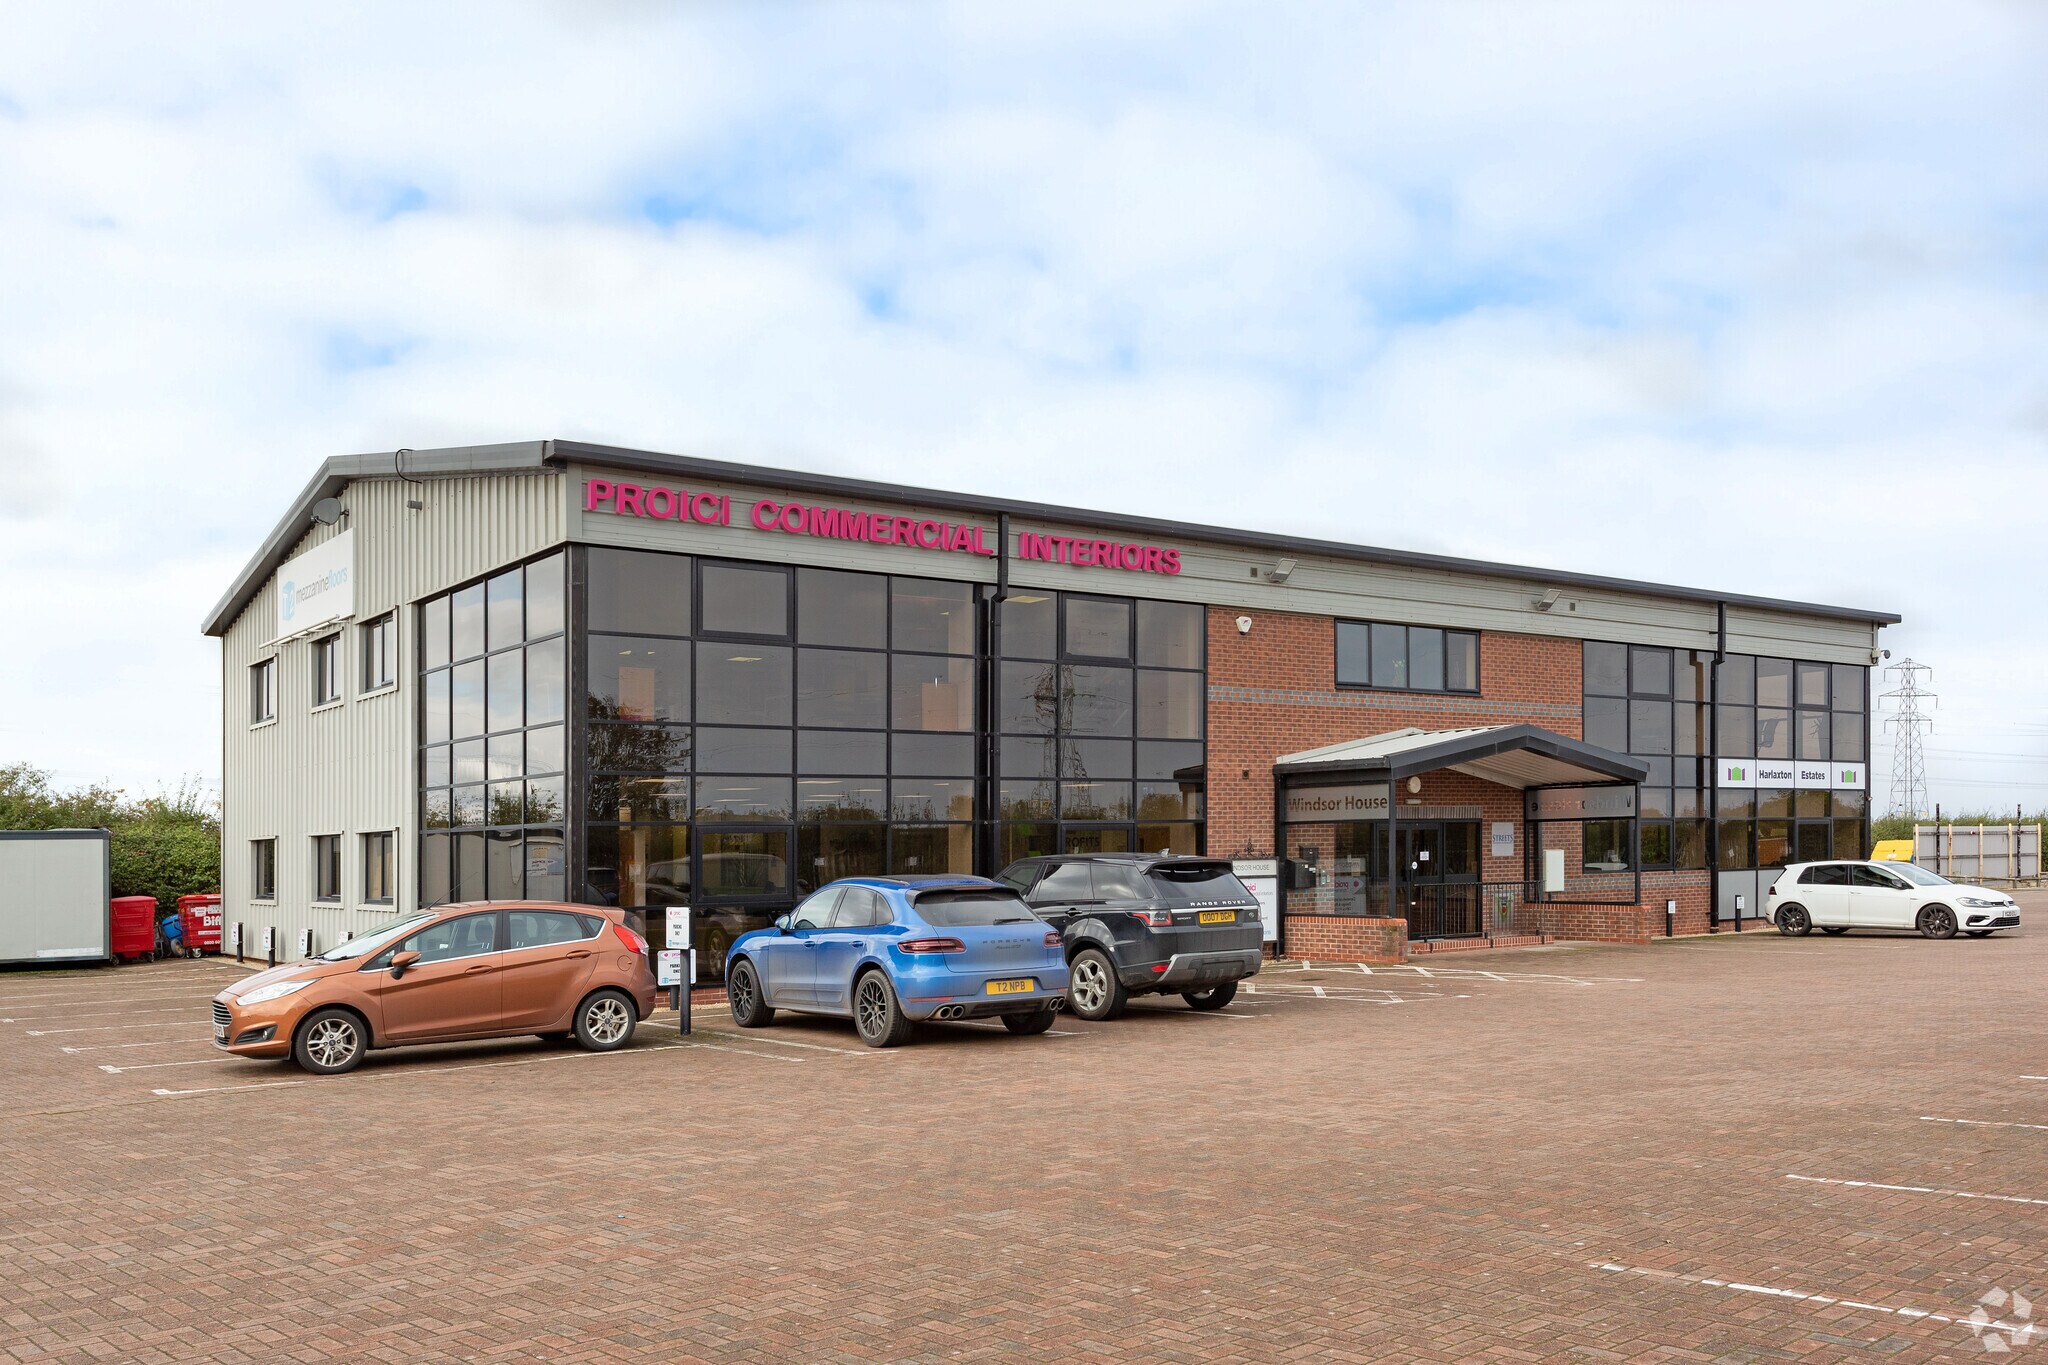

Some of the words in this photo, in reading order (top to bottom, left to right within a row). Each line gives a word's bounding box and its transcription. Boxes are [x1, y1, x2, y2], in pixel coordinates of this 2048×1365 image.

[587, 479, 730, 527] PROICI
[752, 500, 994, 556] COMMERCIAL
[1019, 531, 1182, 576] INTERIORS
[1759, 769, 1792, 780] Harlaxton
[1801, 770, 1825, 780] Estates
[1288, 796, 1342, 812] Windsor
[1345, 796, 1388, 810] House
[1066, 837, 1100, 848] ROFITS
[1492, 834, 1514, 842] STREETS
[203, 915, 221, 927] Biff
[996, 982, 1008, 992] T2
[1009, 981, 1026, 991] NPB
